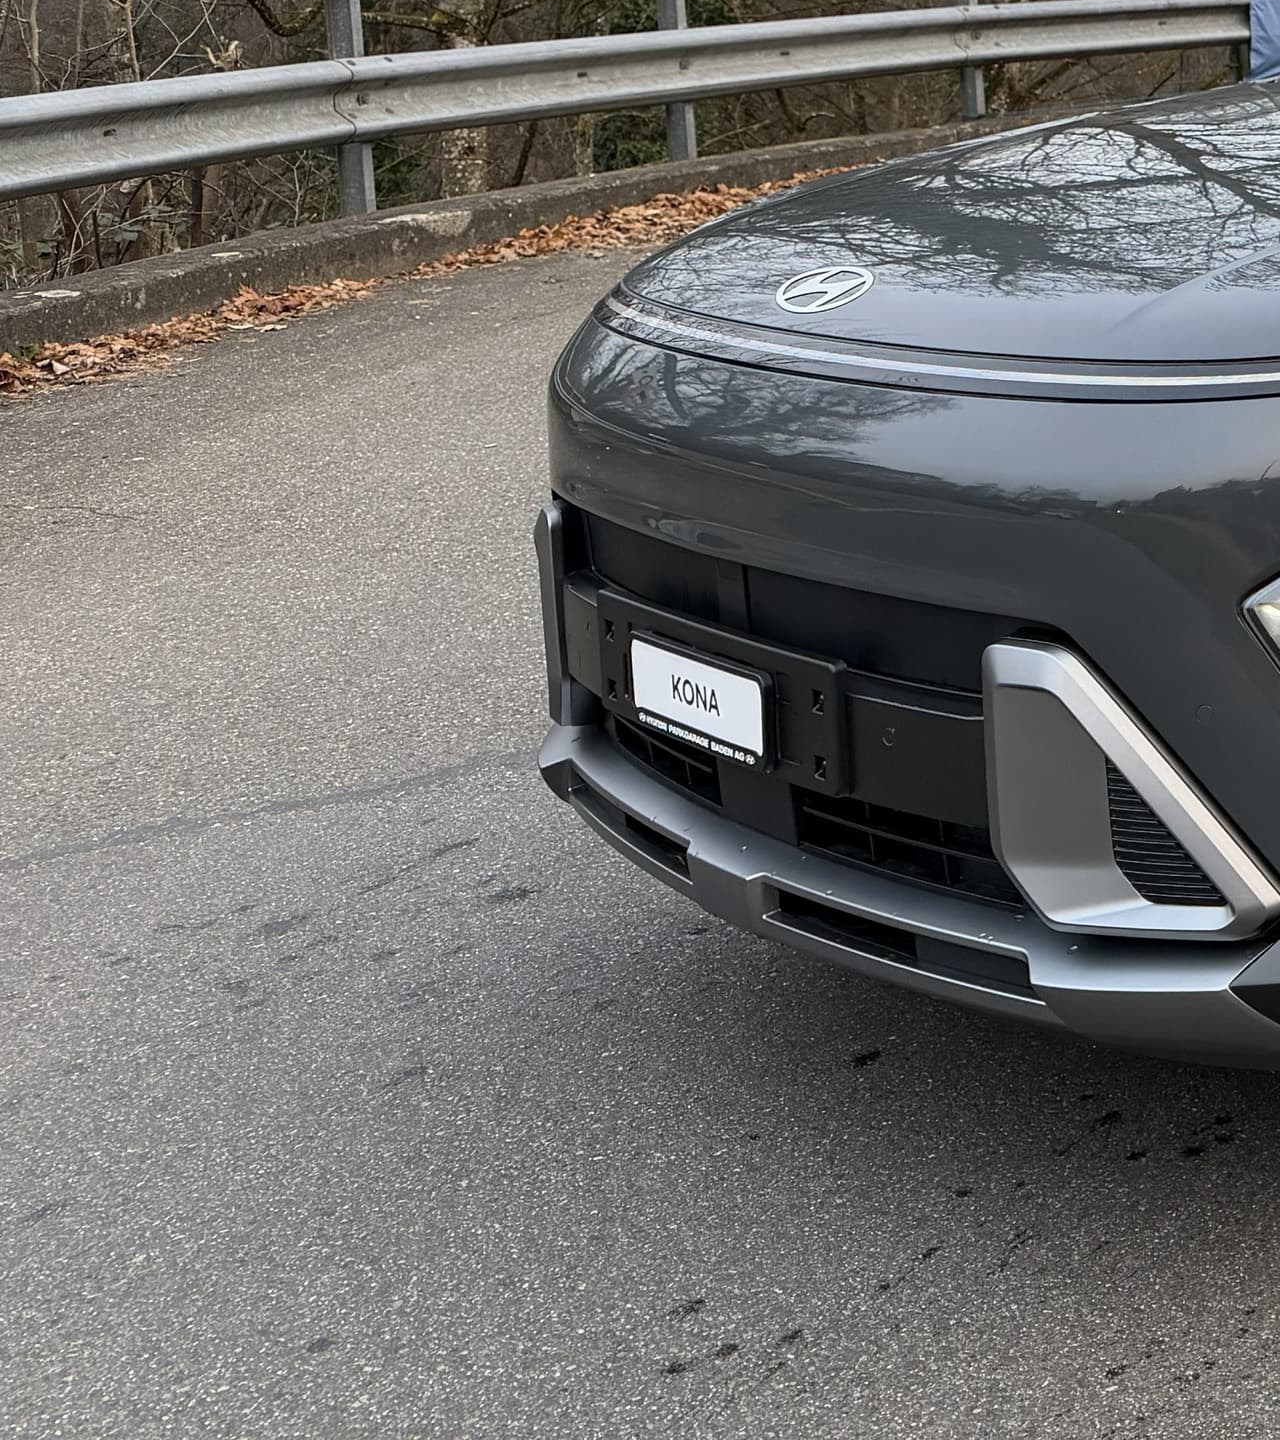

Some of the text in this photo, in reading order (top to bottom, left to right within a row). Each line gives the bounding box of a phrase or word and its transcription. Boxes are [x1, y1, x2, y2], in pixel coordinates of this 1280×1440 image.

[671, 674, 721, 717] KONA
[710, 741, 734, 758] BADEN
[734, 748, 746, 762] AG
